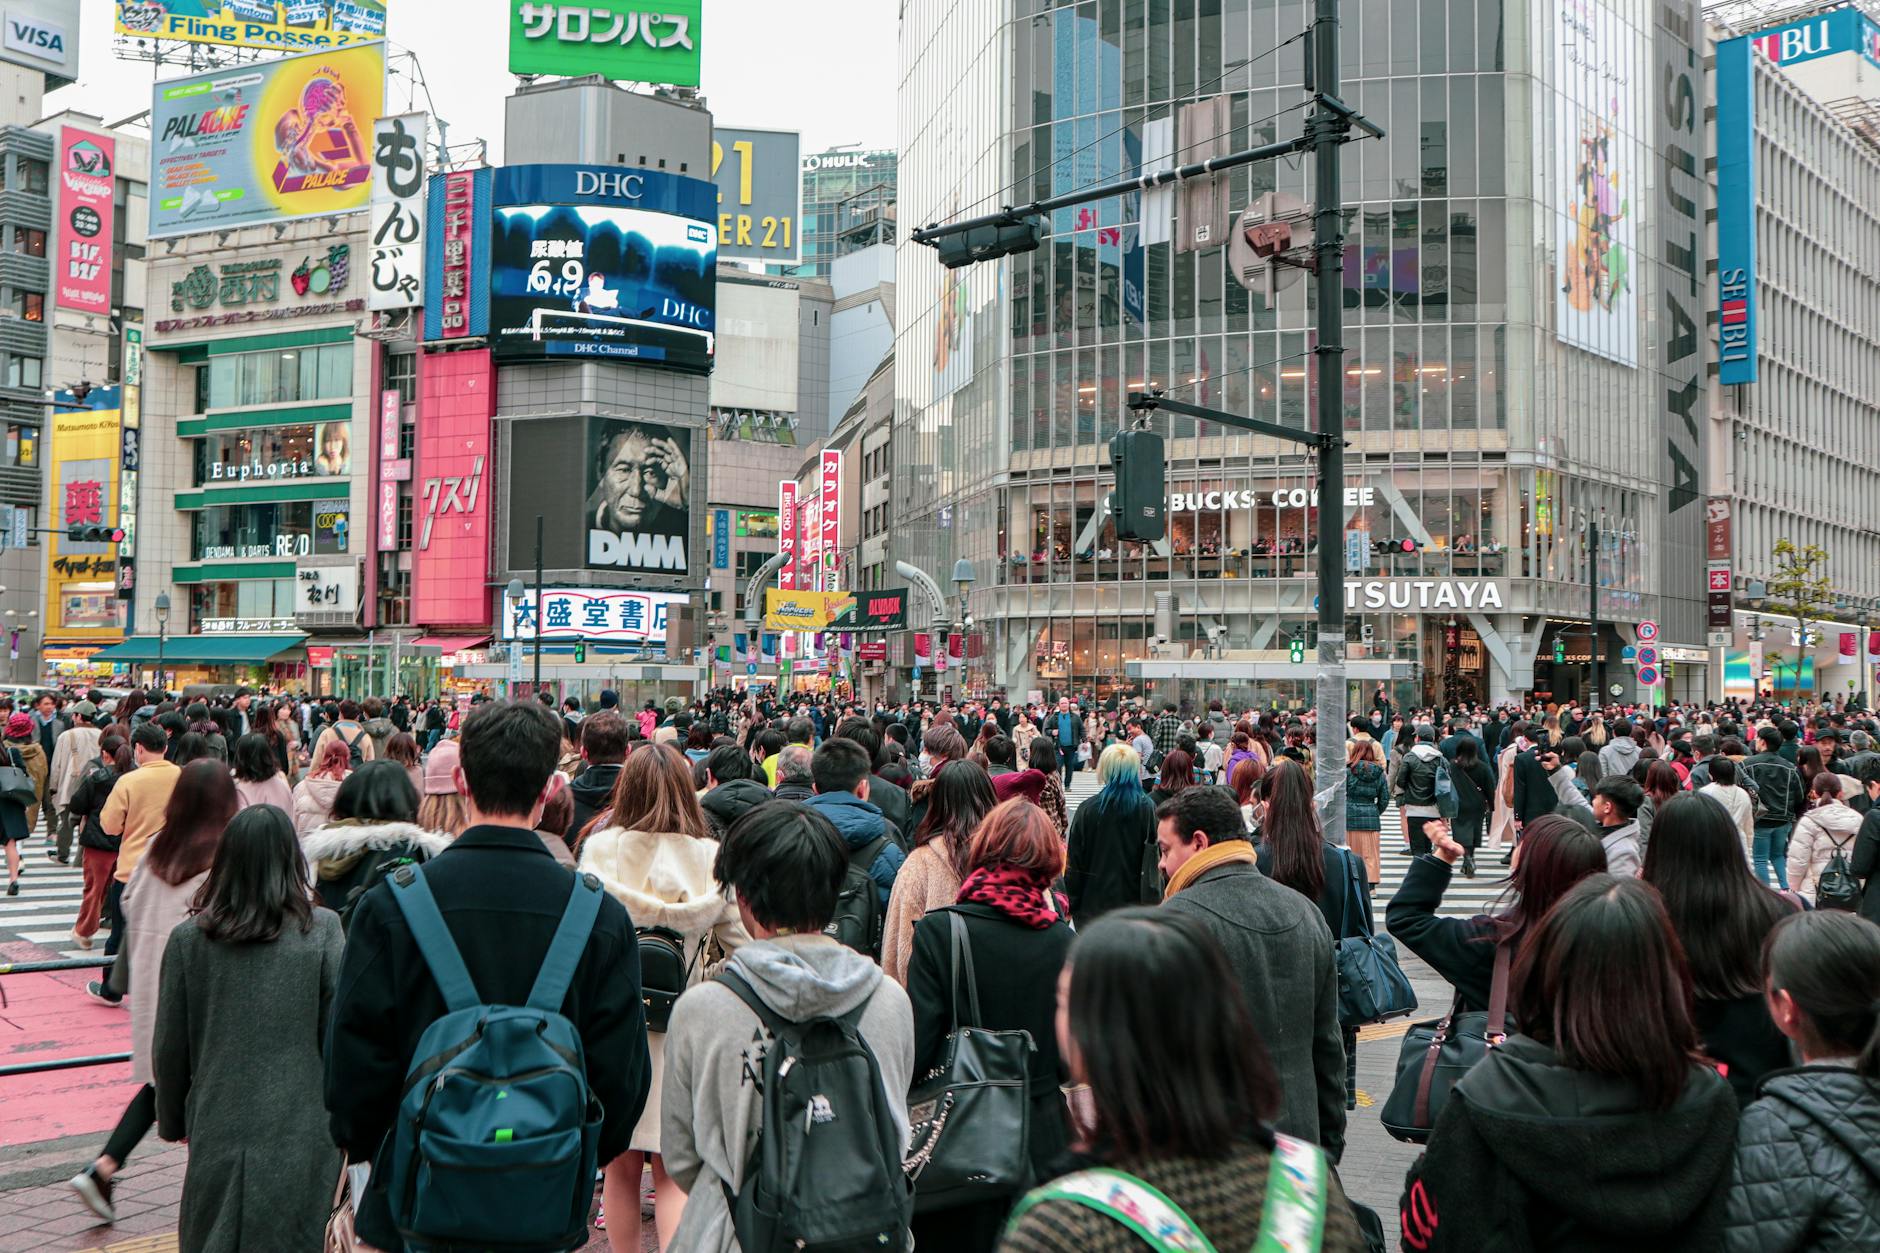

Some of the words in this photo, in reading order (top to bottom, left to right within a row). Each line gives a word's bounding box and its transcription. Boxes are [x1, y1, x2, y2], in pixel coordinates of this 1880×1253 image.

[223, 0, 273, 21] Phantom
[287, 9, 313, 21] easy
[334, 15, 354, 29] Dead
[9, 20, 64, 53] VISA
[169, 16, 237, 41] Fling
[244, 24, 331, 48] Posse
[518, 2, 693, 51] サロンパス
[1762, 20, 1832, 61] IBU
[822, 154, 870, 168] HULIC
[302, 169, 348, 190] PALACE
[575, 171, 644, 199] DHC
[373, 119, 423, 302] もんじゃ
[689, 227, 708, 241] DHC
[761, 216, 791, 248] 21
[70, 240, 101, 261] B1F
[442, 177, 467, 328] 三千里薬品
[530, 240, 584, 258] 尿酸値
[69, 259, 101, 280] B2F
[662, 298, 710, 327] DHC
[1721, 267, 1748, 366] SEIBU
[574, 343, 598, 353] DHC
[598, 345, 639, 356] Channel
[56, 422, 98, 432] Matsumoto
[211, 457, 309, 482] Euphoria
[65, 480, 102, 525] 薬
[418, 455, 485, 551] クスリ
[822, 460, 838, 531] カラオケ
[1104, 489, 1256, 514] BUCKS
[1271, 487, 1375, 508] COFEE
[248, 545, 270, 557] DARTS
[589, 530, 687, 571] DMM
[1711, 571, 1728, 589] 本
[1343, 581, 1503, 609] TSUTAYA
